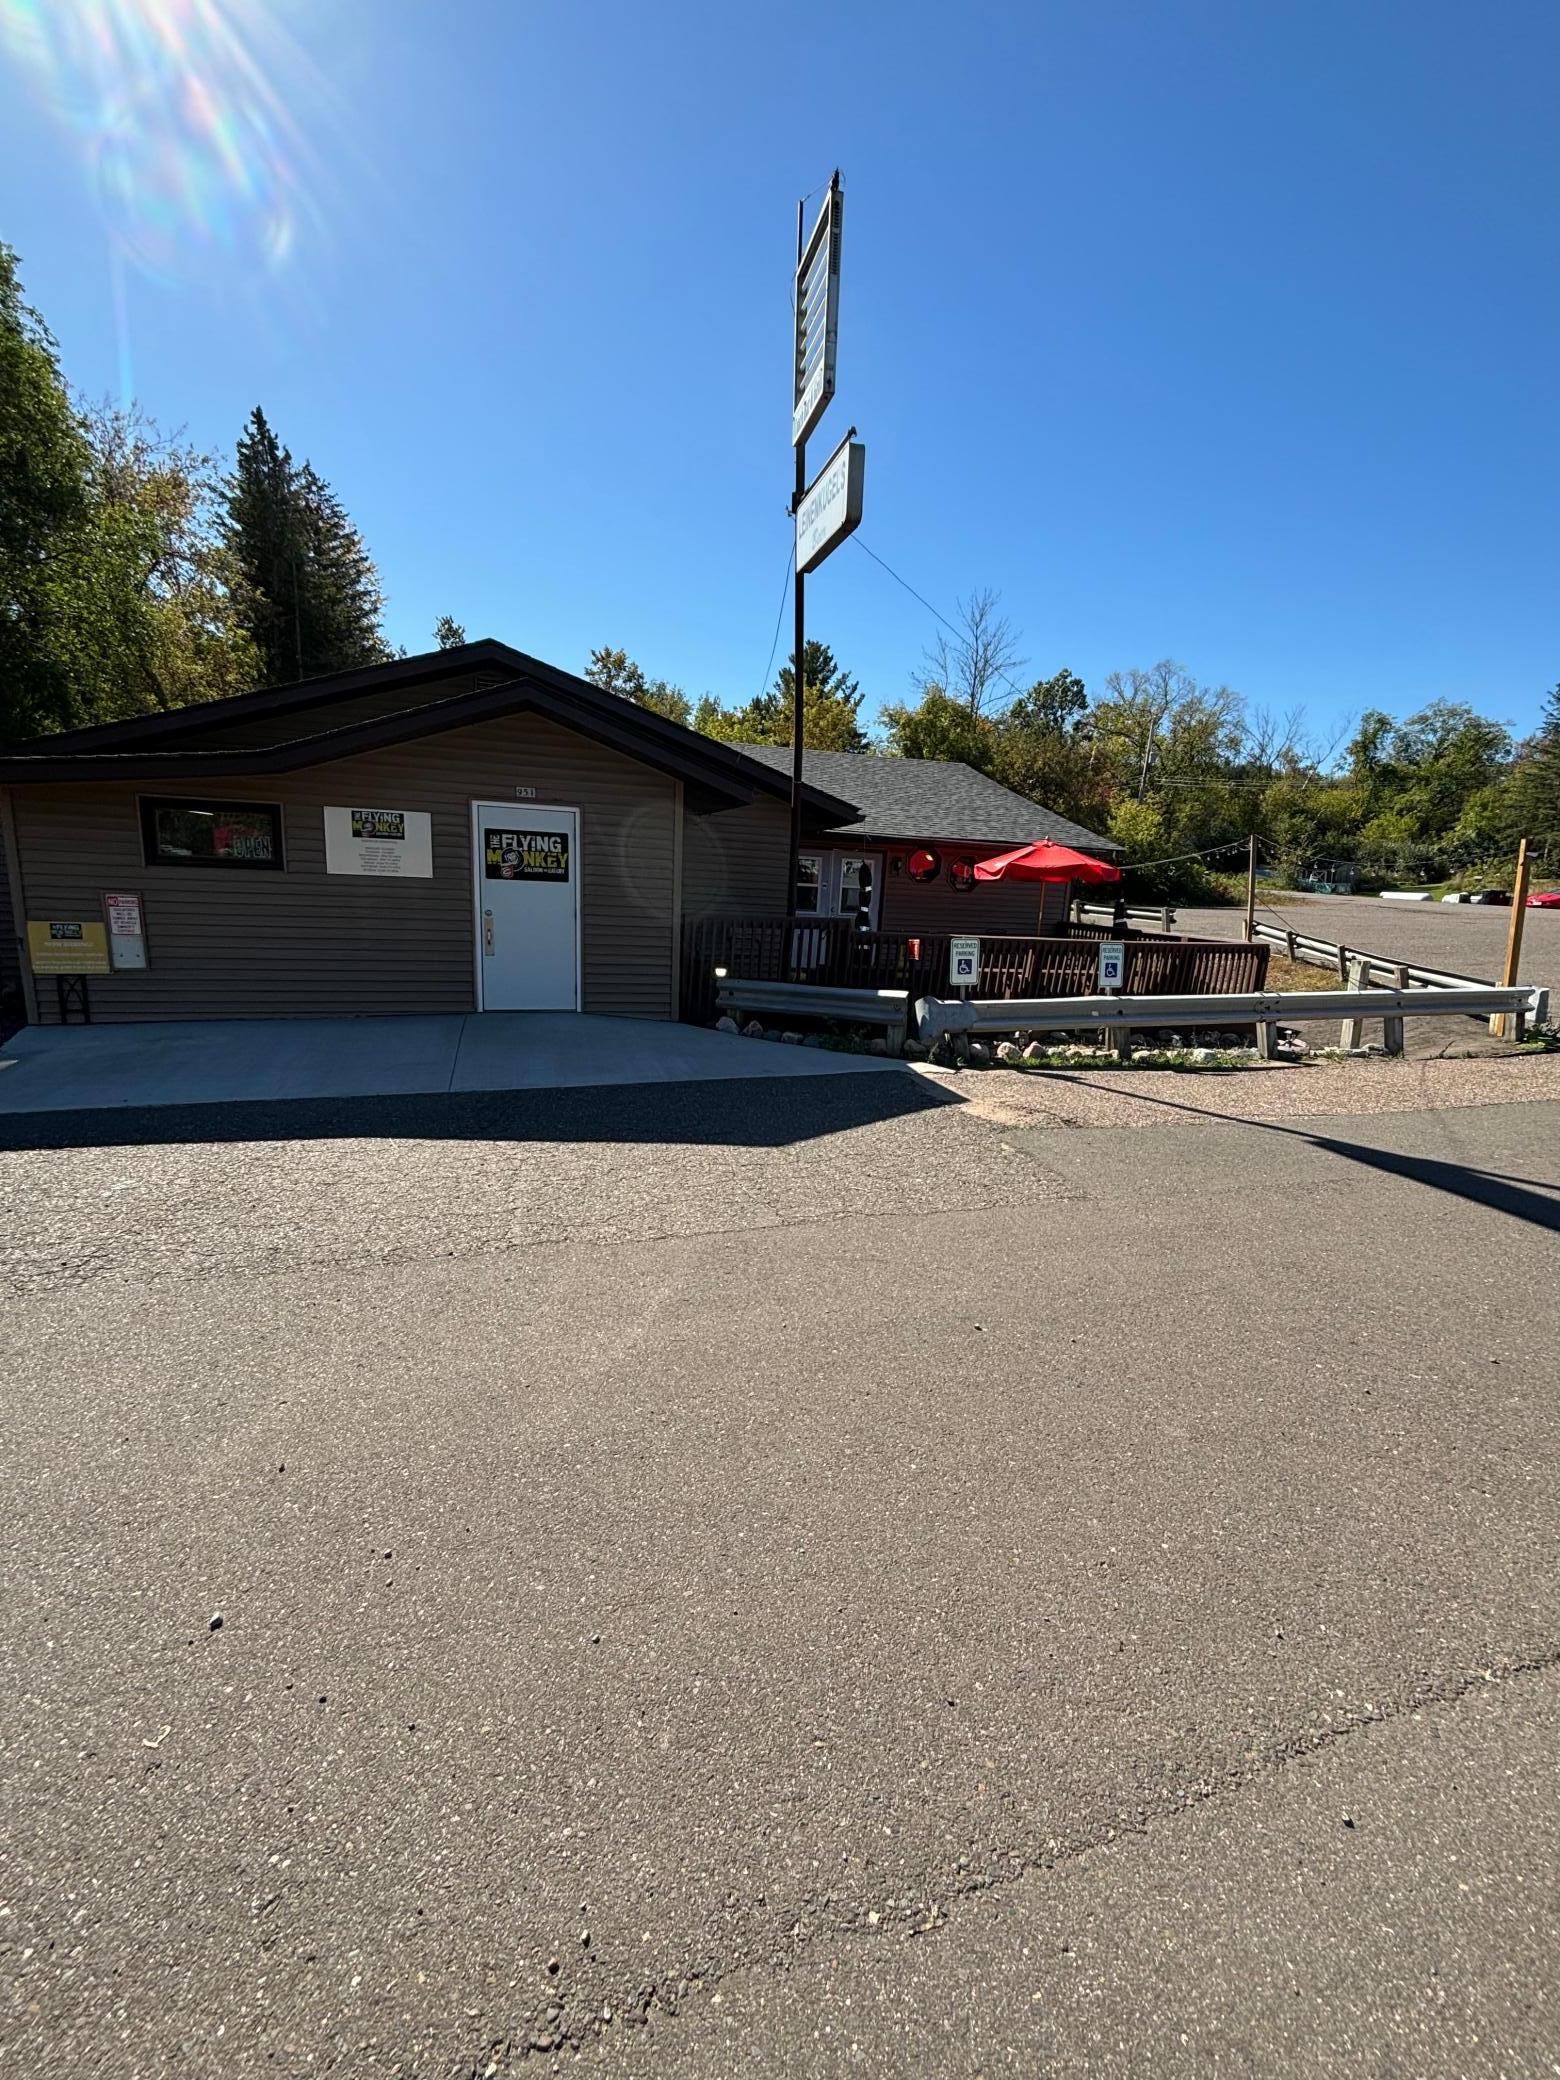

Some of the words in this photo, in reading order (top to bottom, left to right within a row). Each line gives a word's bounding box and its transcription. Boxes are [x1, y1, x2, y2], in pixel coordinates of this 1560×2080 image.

[516, 788, 535, 797] 951
[490, 834, 500, 848] THE
[234, 836, 273, 858] OPEN
[108, 897, 117, 906] NO
